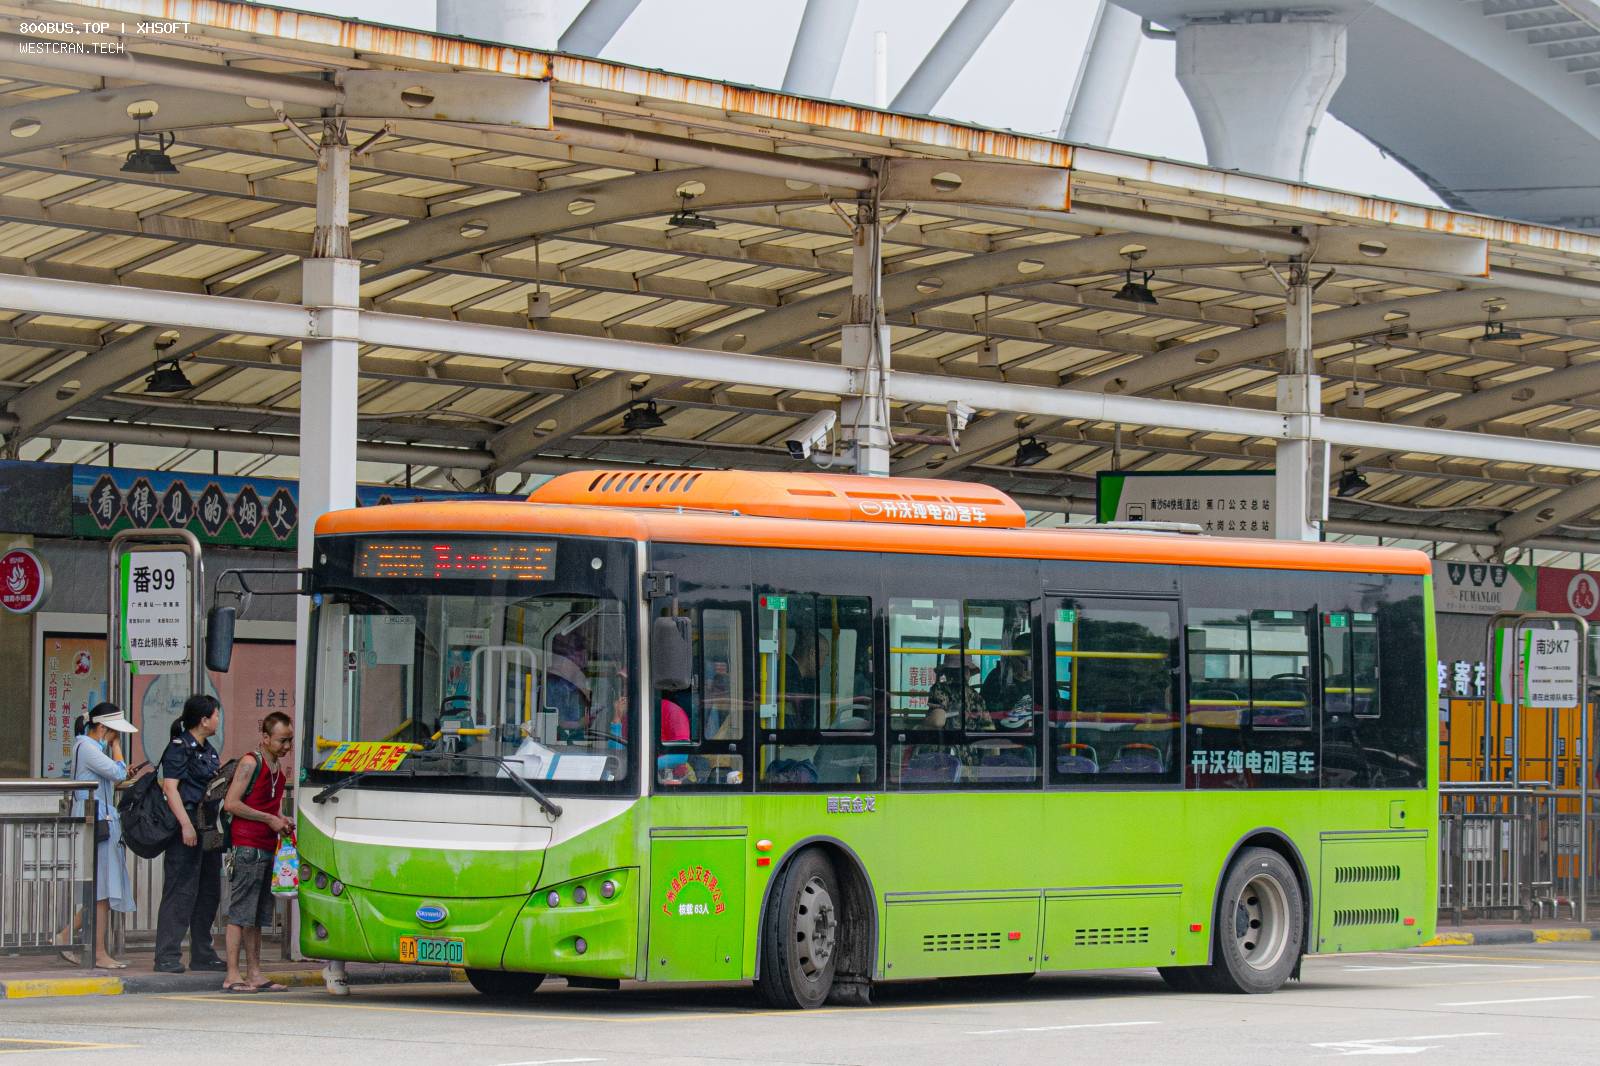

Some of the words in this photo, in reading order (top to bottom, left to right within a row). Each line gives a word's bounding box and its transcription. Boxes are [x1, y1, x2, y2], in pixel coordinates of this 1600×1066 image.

[97, 484, 292, 531] 看得见的烟火
[881, 501, 987, 523] 开沃纯电动客车
[1206, 519, 1270, 532] 大岗公交总站
[132, 566, 175, 593] 番99
[130, 637, 179, 648] 请在此排队候车
[1536, 639, 1570, 655] 南沙K7
[255, 688, 295, 708] 社会主
[1191, 750, 1315, 774] 开沃纯电动客车
[827, 796, 876, 814] 南京金龙
